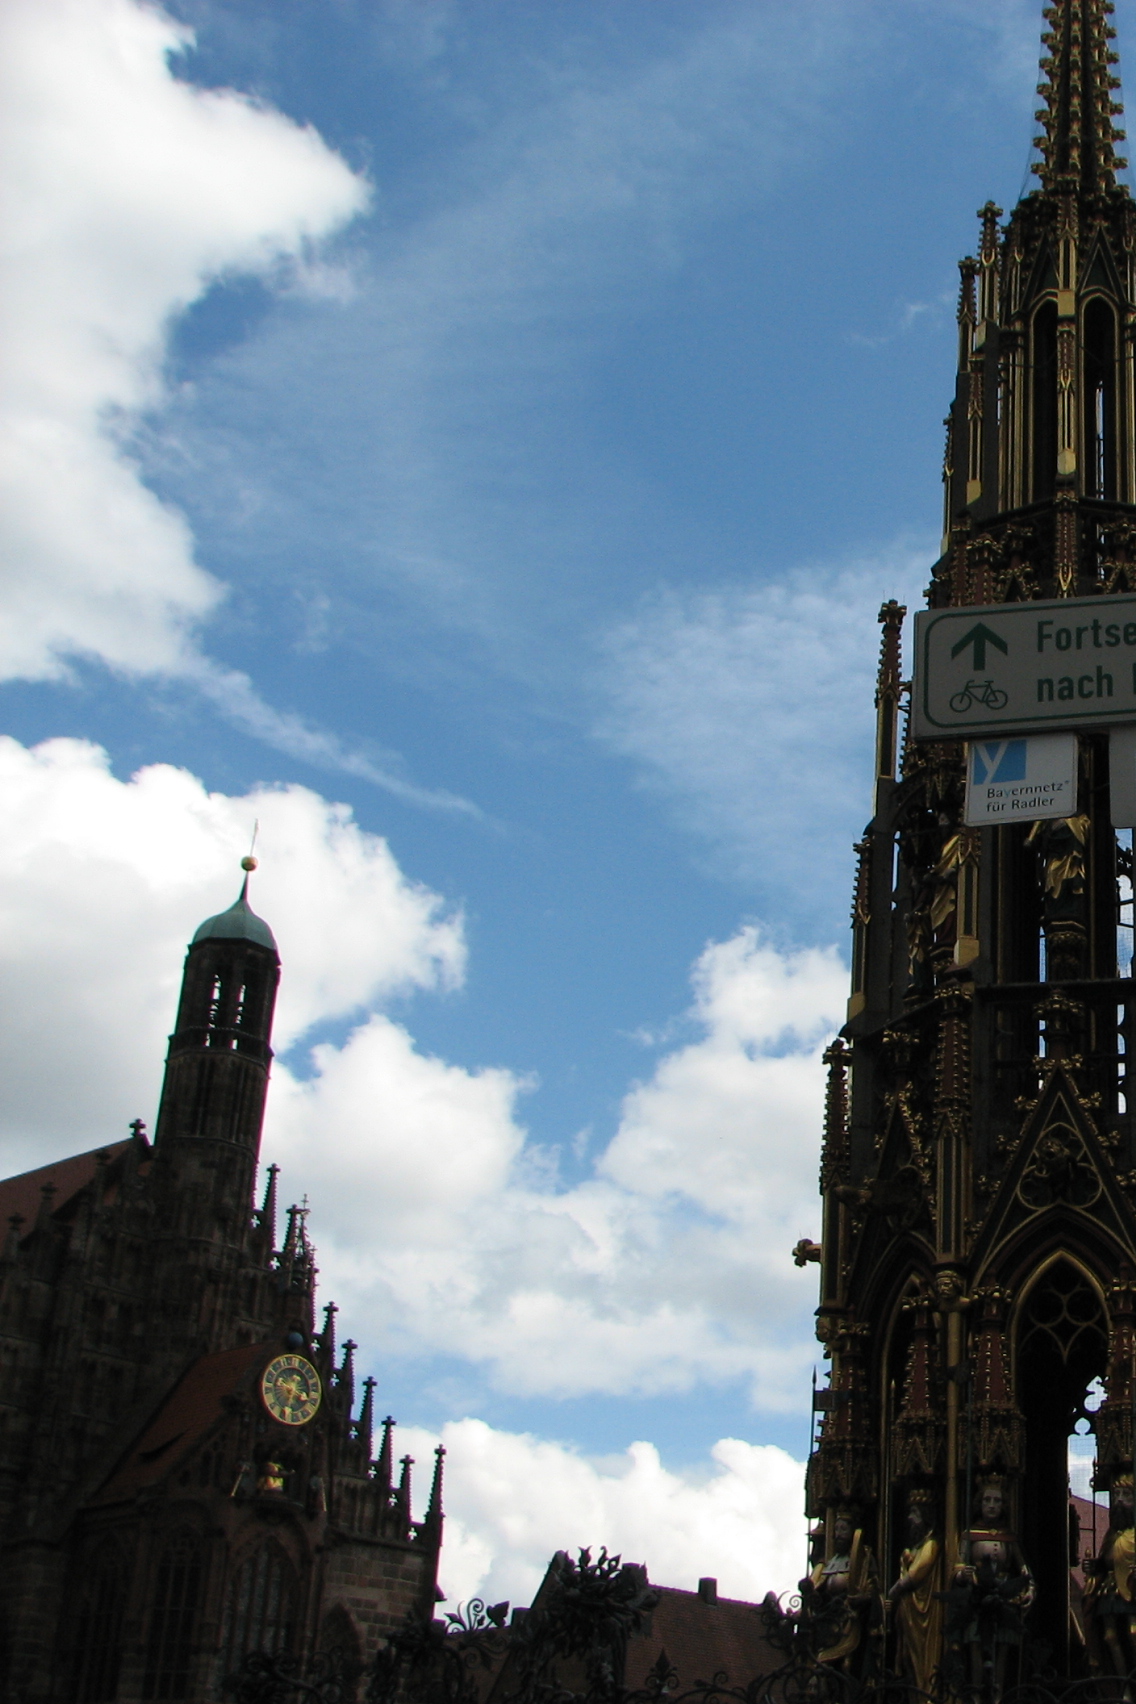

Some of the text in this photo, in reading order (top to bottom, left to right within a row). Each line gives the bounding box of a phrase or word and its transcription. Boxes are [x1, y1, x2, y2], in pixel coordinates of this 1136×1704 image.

[1036, 669, 1114, 702] nach
[987, 797, 1055, 812] für Radler
